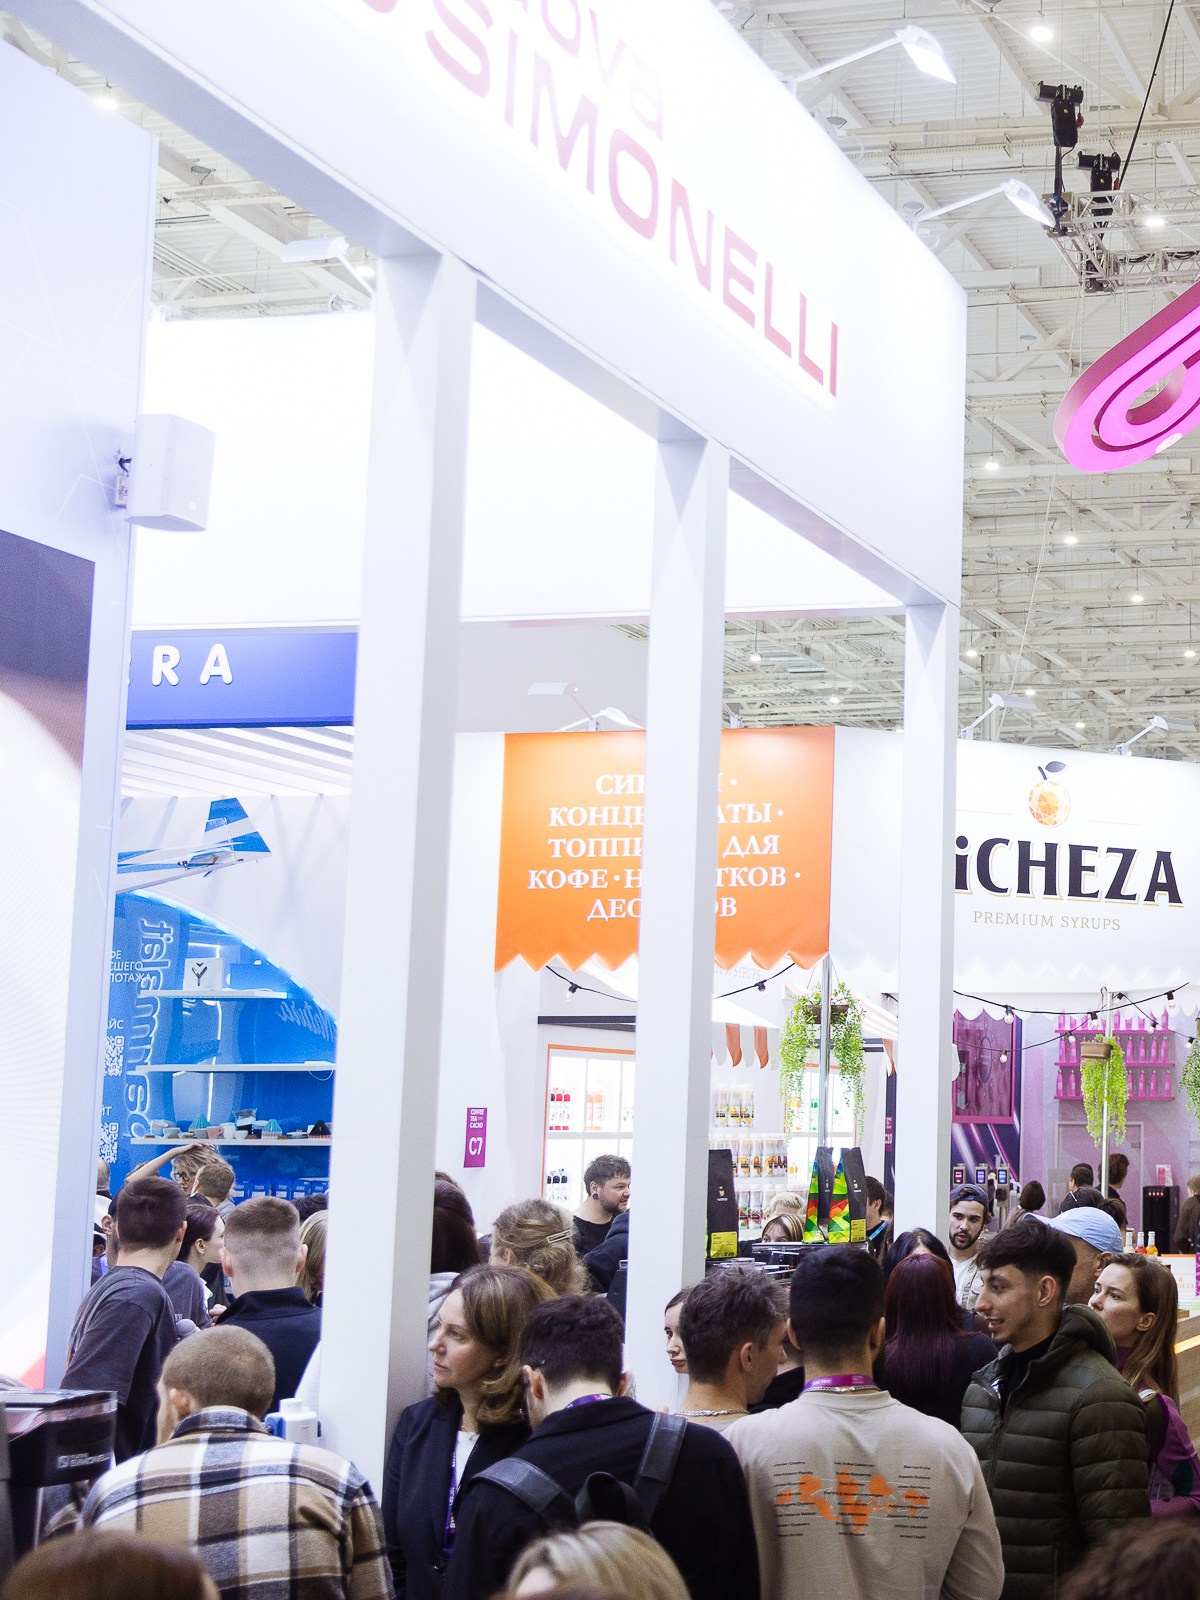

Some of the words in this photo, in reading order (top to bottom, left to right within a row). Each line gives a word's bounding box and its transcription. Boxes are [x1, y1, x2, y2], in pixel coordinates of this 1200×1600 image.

[512, 0, 664, 142] ova
[425, 0, 838, 398] SIMONELLI
[722, 834, 780, 859] ДЛЯ
[528, 869, 608, 889] КОФЕ
[973, 910, 1054, 928] PREMIUM
[1061, 916, 1121, 931] SYRUPS
[468, 1137, 483, 1156] C7
